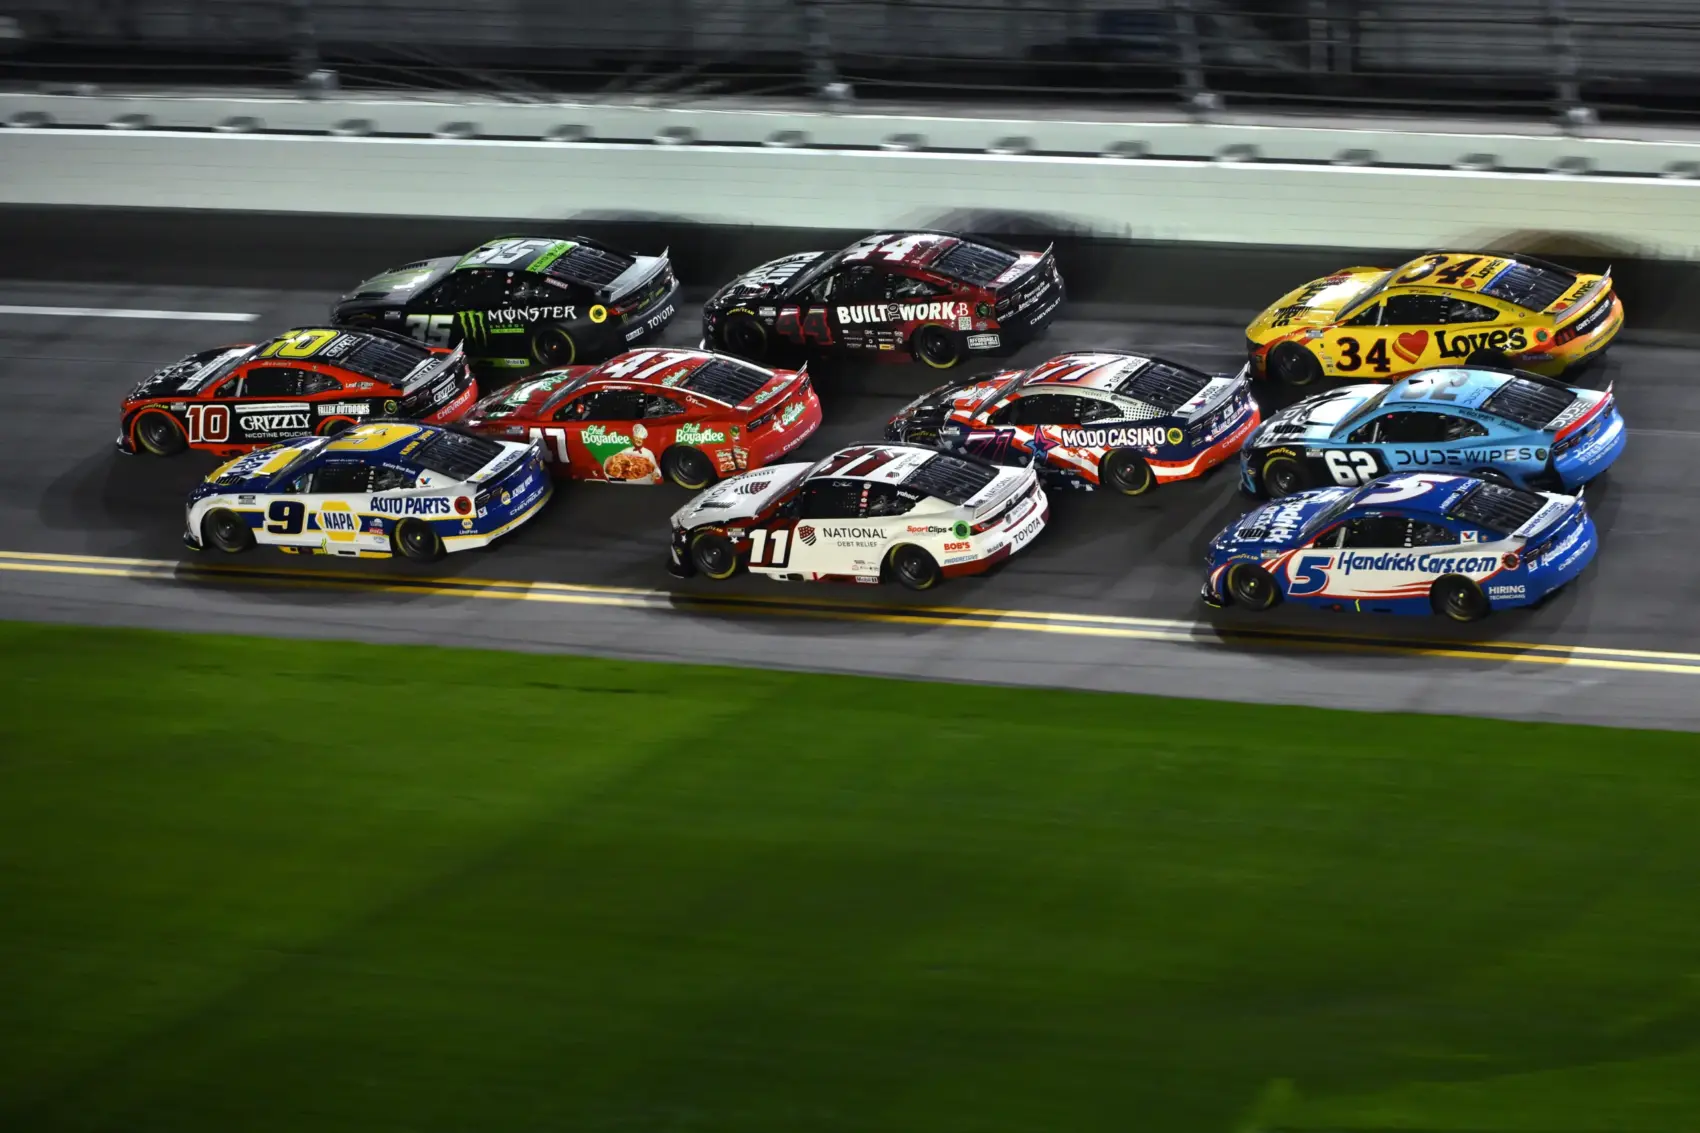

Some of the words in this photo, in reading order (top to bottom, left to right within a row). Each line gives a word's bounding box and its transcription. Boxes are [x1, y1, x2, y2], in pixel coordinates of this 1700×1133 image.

[842, 233, 940, 261] 44
[487, 306, 578, 324] MONSTER
[647, 304, 676, 330] TOYOTA
[775, 304, 834, 346] 44
[837, 305, 887, 324] BUILT
[900, 302, 957, 321] WORK
[1030, 297, 1061, 325] CHEVROLET
[258, 329, 341, 359] 10
[406, 313, 454, 349] 35
[601, 351, 713, 380] 47
[1335, 336, 1393, 373] 34
[437, 391, 472, 420] CHEVROLET
[186, 405, 230, 443] 10
[240, 415, 311, 432] GRIZZLY
[245, 431, 278, 441] NICOTINE
[281, 430, 312, 440] POUCHES
[783, 421, 817, 452] CHEVROLET
[1062, 429, 1107, 448] MODO
[1107, 427, 1166, 447] CASINO
[1222, 419, 1255, 449] CHEVROLET
[810, 447, 906, 477] 11
[1267, 447, 1297, 460] GOODYEAR
[1395, 449, 1462, 466] DUDE
[1463, 447, 1532, 464] WIPES
[1325, 450, 1379, 487] 62
[370, 497, 403, 515] AUTO
[405, 497, 451, 515] PARTS
[509, 486, 545, 516] CHEVROLET
[267, 500, 306, 535] 9
[323, 512, 355, 531] NAPA
[1012, 518, 1042, 545] TOYOTA
[748, 528, 791, 564] 11
[823, 527, 888, 539] NATIONAL
[944, 543, 970, 552] BOB'S
[1288, 556, 1335, 597] 5
[1335, 552, 1416, 575] Hendrick
[1418, 554, 1496, 575] Cars.com
[1489, 585, 1525, 594] HIRING
